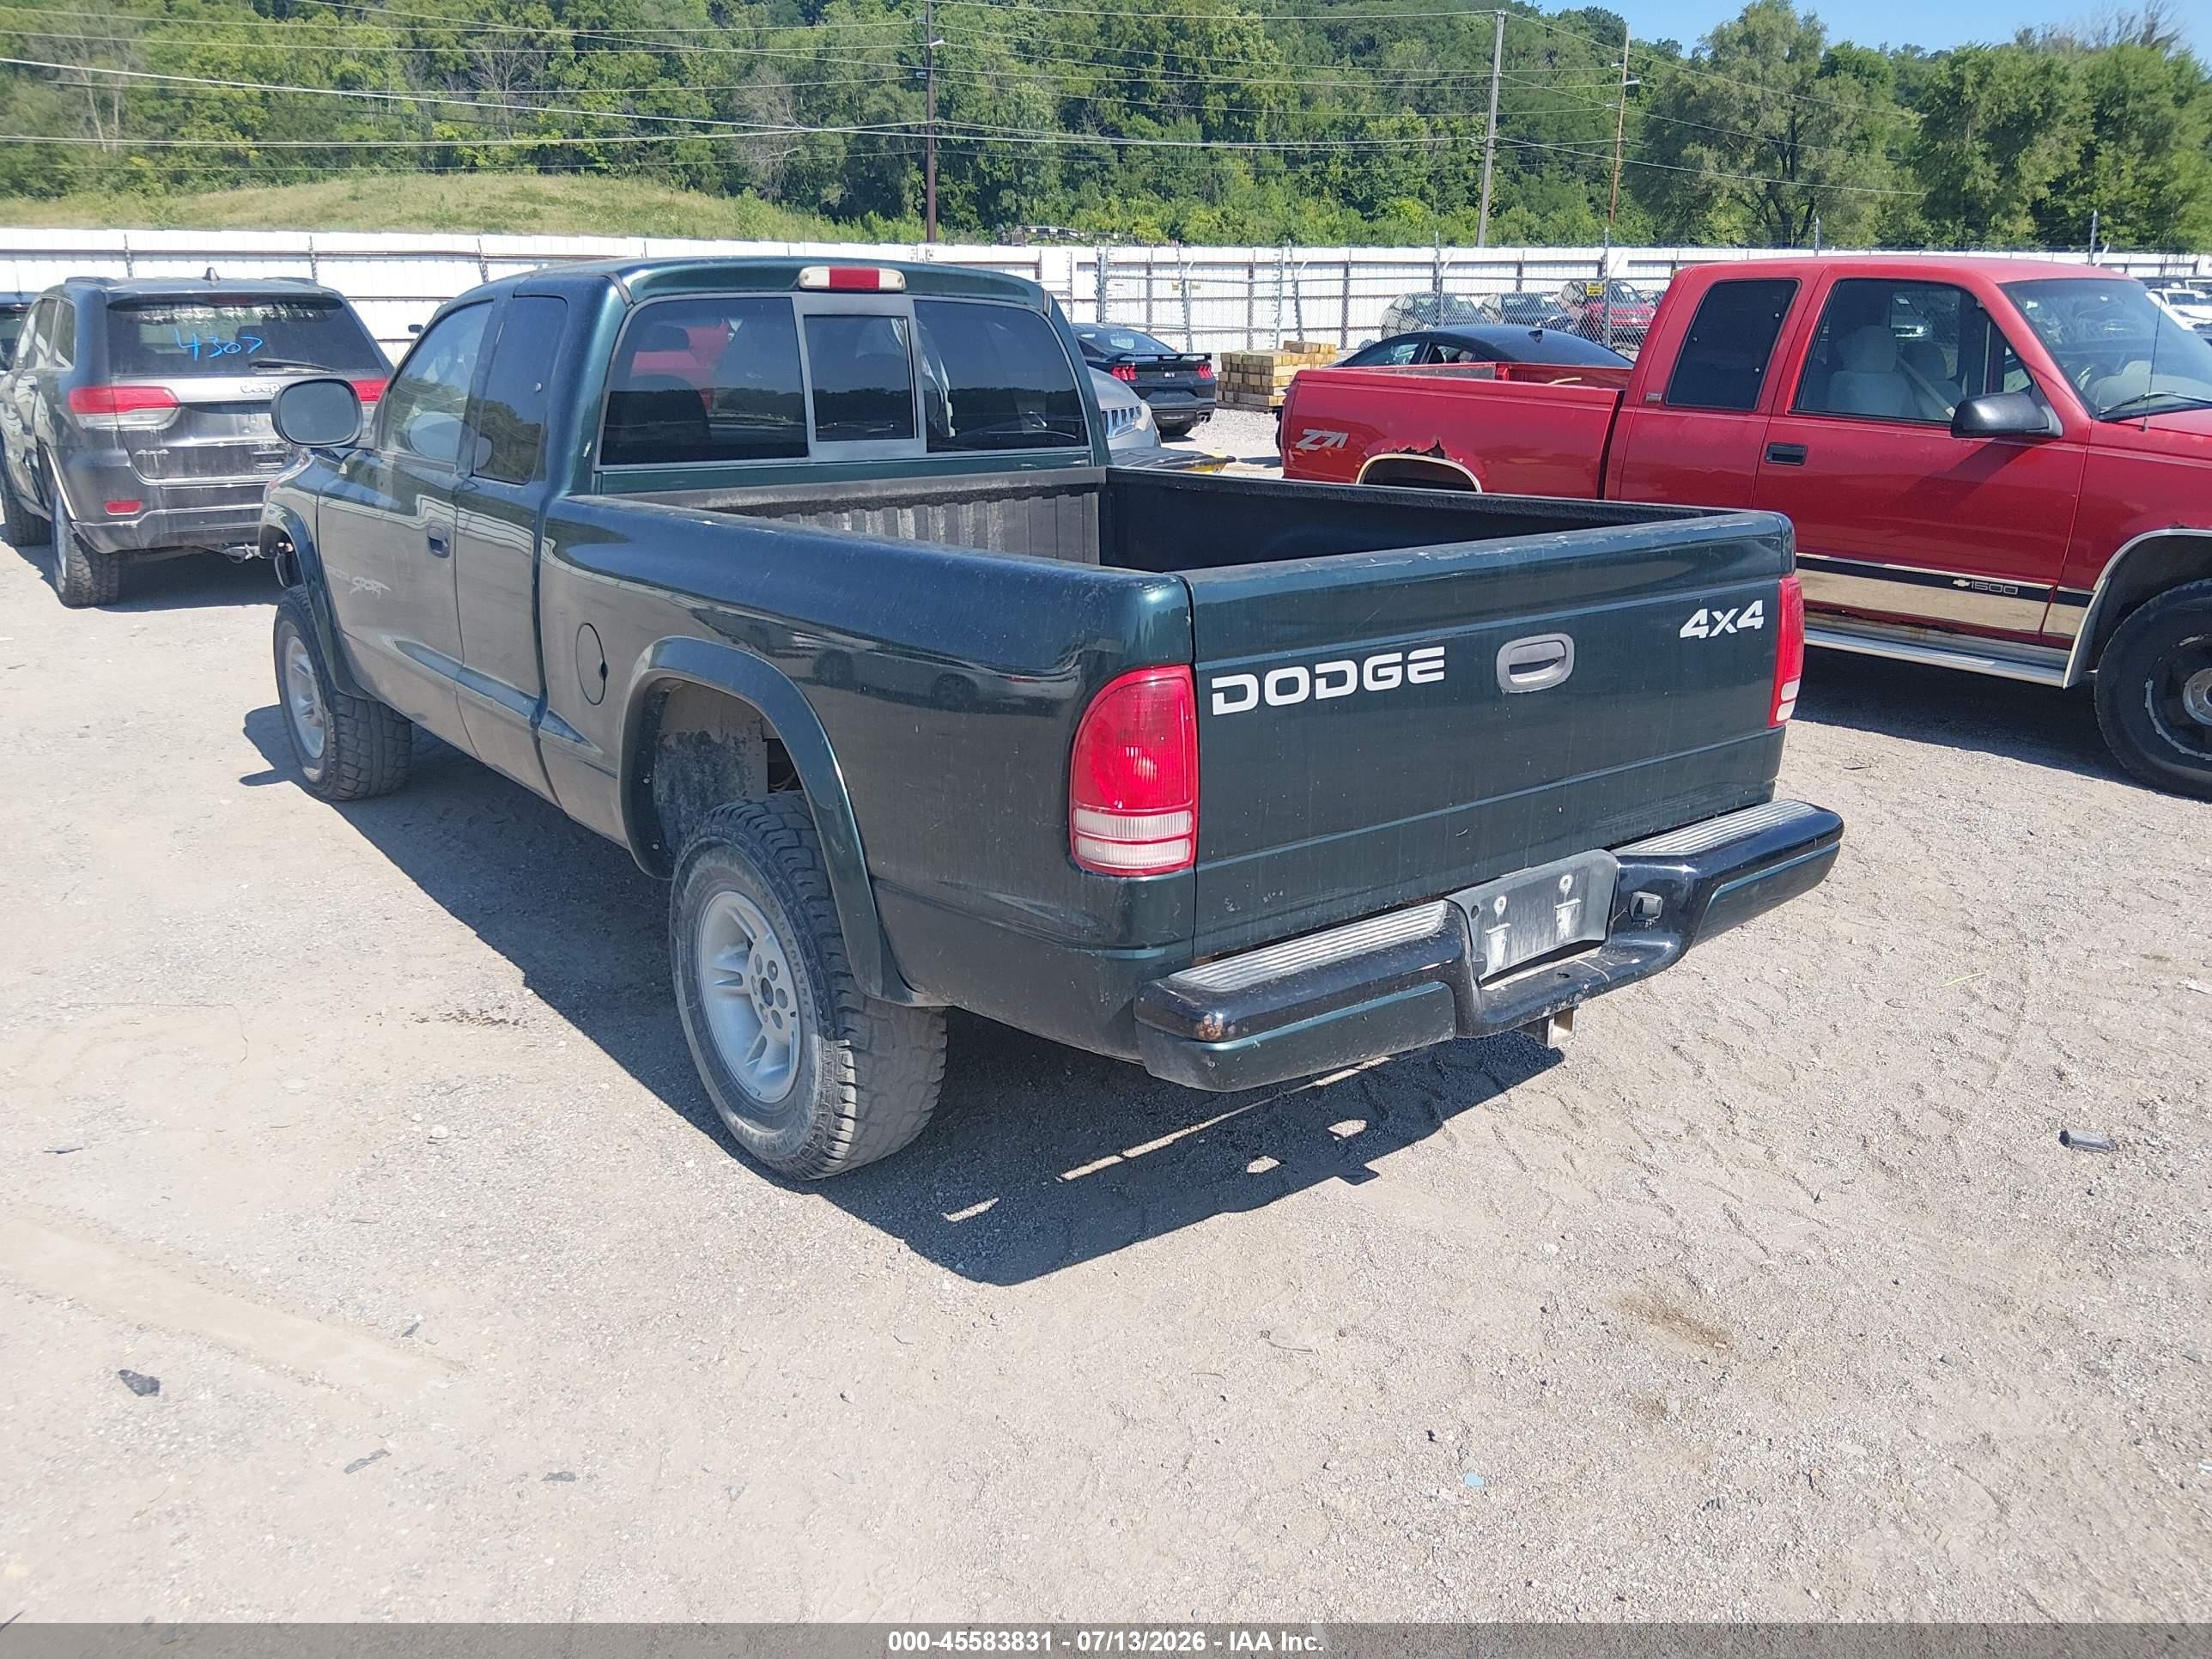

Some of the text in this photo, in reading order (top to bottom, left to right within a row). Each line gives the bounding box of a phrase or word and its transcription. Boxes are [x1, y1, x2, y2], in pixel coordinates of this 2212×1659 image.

[174, 329, 263, 361] 4307
[240, 380, 282, 395] Jeep
[1295, 428, 1349, 451] Z71
[1971, 580, 2019, 595] 1500
[1211, 646, 1445, 716] DODGE
